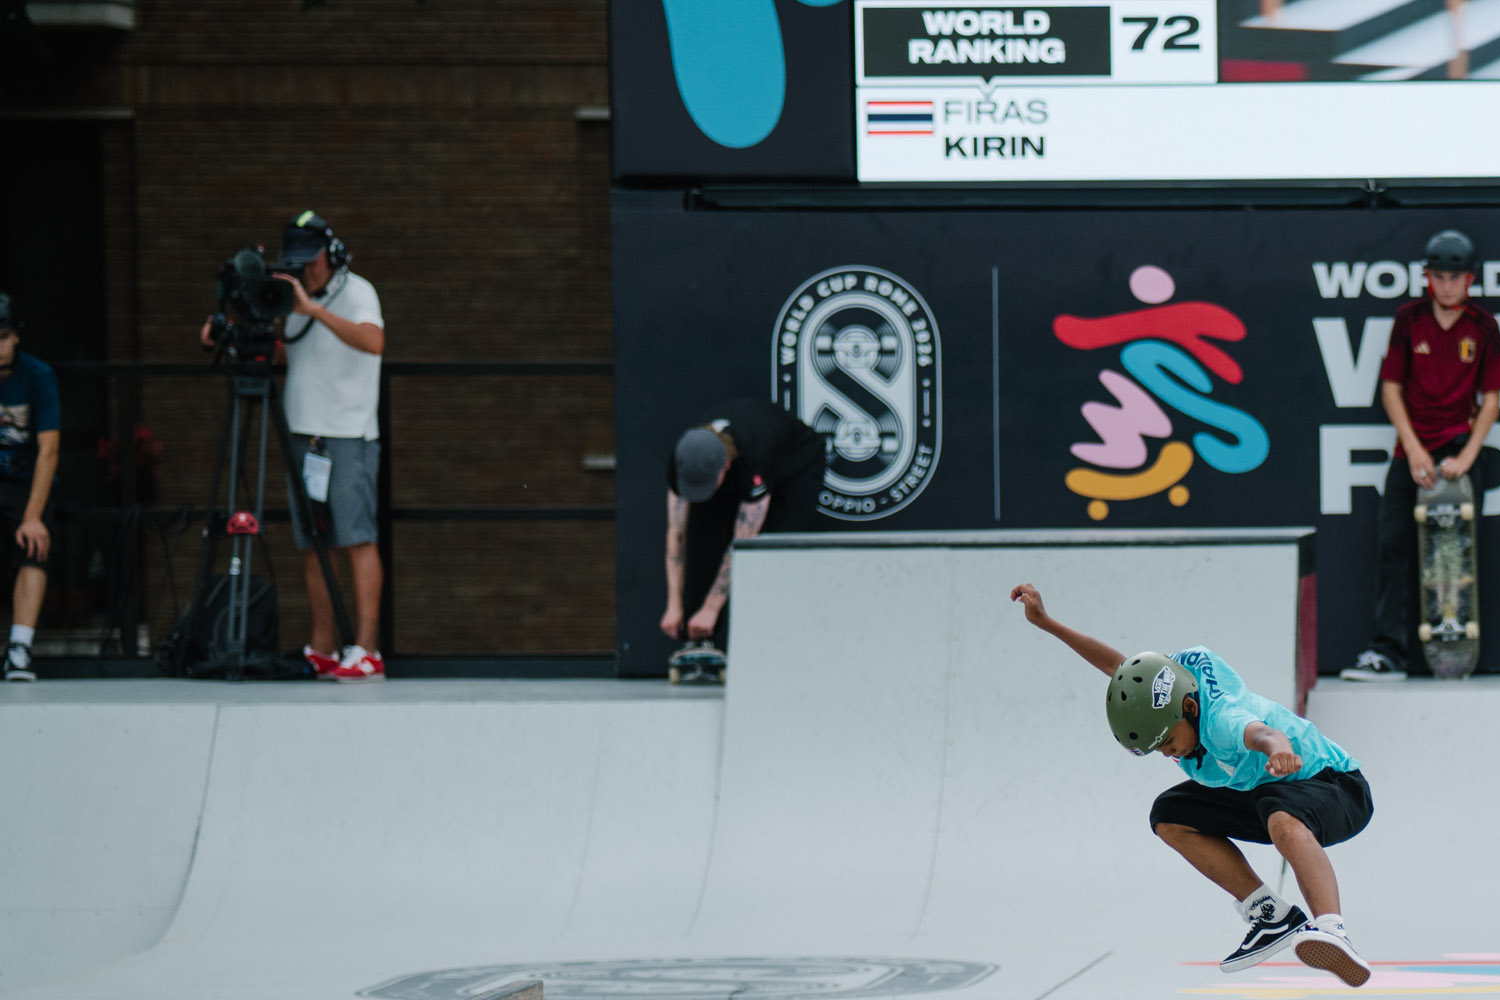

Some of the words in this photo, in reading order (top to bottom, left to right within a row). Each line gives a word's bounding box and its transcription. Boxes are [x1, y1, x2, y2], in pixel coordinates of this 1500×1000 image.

[922, 9, 1050, 35] WORLD
[1121, 14, 1201, 51] 72
[908, 37, 1066, 64] RANKING
[944, 100, 1048, 124] FIRAS
[944, 135, 1045, 158] KIRIN
[780, 294, 815, 366] WORLD
[816, 274, 858, 298] CUP
[863, 275, 919, 317] ROME
[911, 317, 934, 368] 2026
[818, 489, 876, 514] OPPIO
[889, 444, 934, 503] STREET
